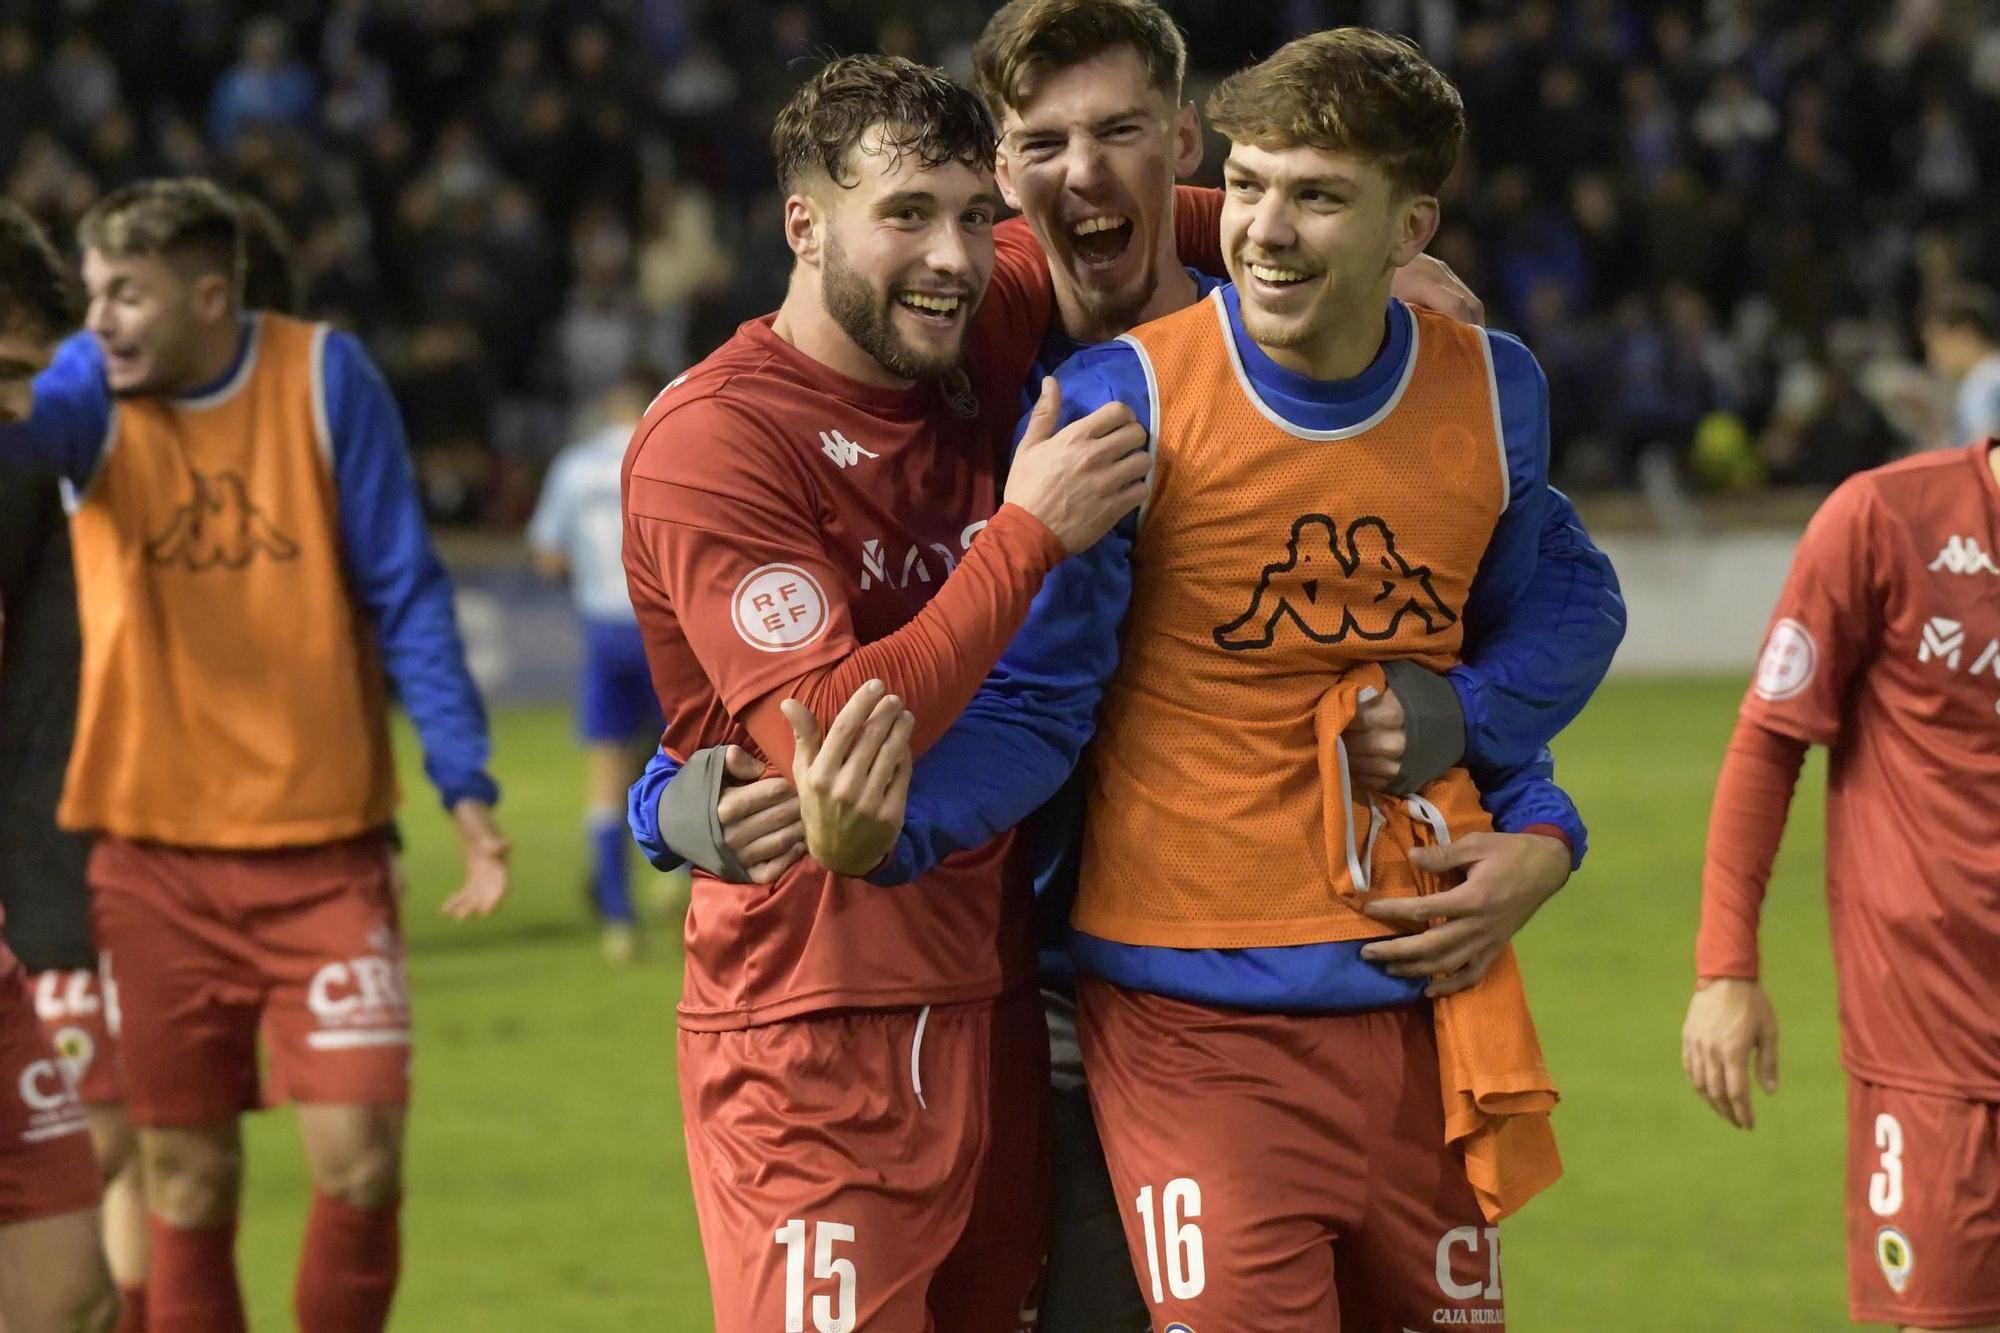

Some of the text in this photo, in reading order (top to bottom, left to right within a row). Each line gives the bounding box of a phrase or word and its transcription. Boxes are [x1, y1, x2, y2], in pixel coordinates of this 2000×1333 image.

[1869, 1113, 1903, 1217] 3
[775, 1219, 856, 1333] 15
[1136, 1177, 1205, 1303] 16
[1432, 1308, 1468, 1324] CAJA
